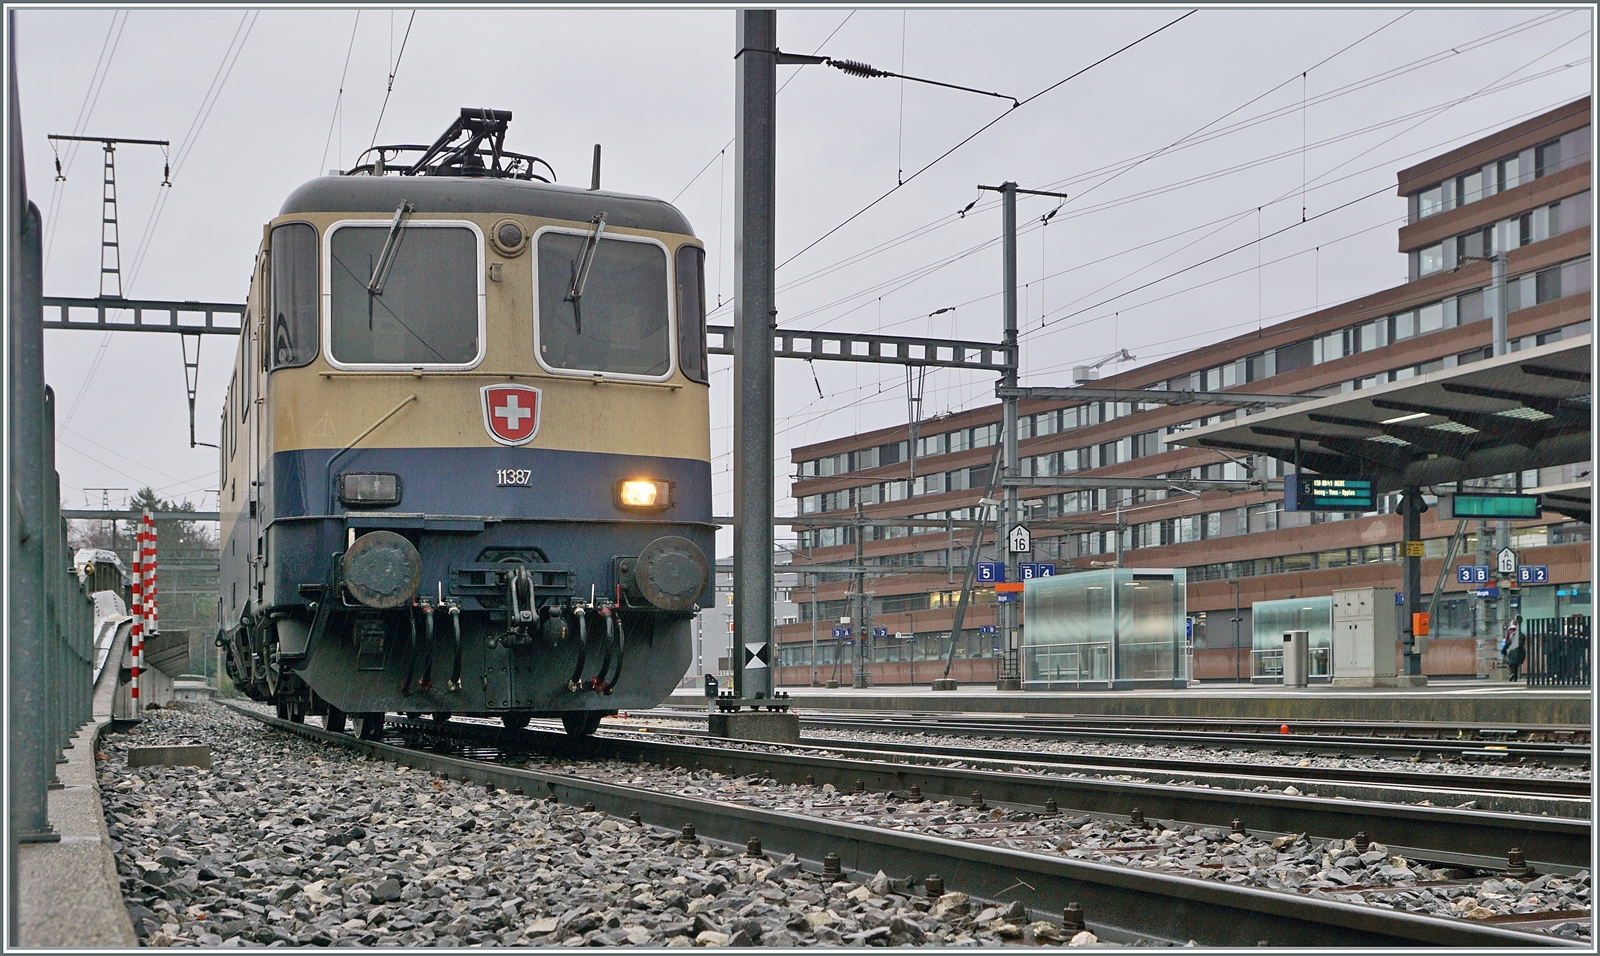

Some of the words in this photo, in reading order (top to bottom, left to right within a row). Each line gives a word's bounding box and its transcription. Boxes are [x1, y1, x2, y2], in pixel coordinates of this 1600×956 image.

[496, 469, 532, 485] 11387
[1304, 484, 1310, 493] 5
[1016, 528, 1023, 537] A
[1014, 538, 1026, 551] 16
[1503, 550, 1509, 558] A
[1502, 560, 1512, 571] 16
[982, 568, 990, 578] 5
[1024, 569, 1032, 578] B
[1043, 569, 1050, 577] 4
[1462, 571, 1470, 580] 3
[1477, 571, 1485, 580] B
[1522, 570, 1529, 580] B
[1537, 570, 1544, 580] 2
